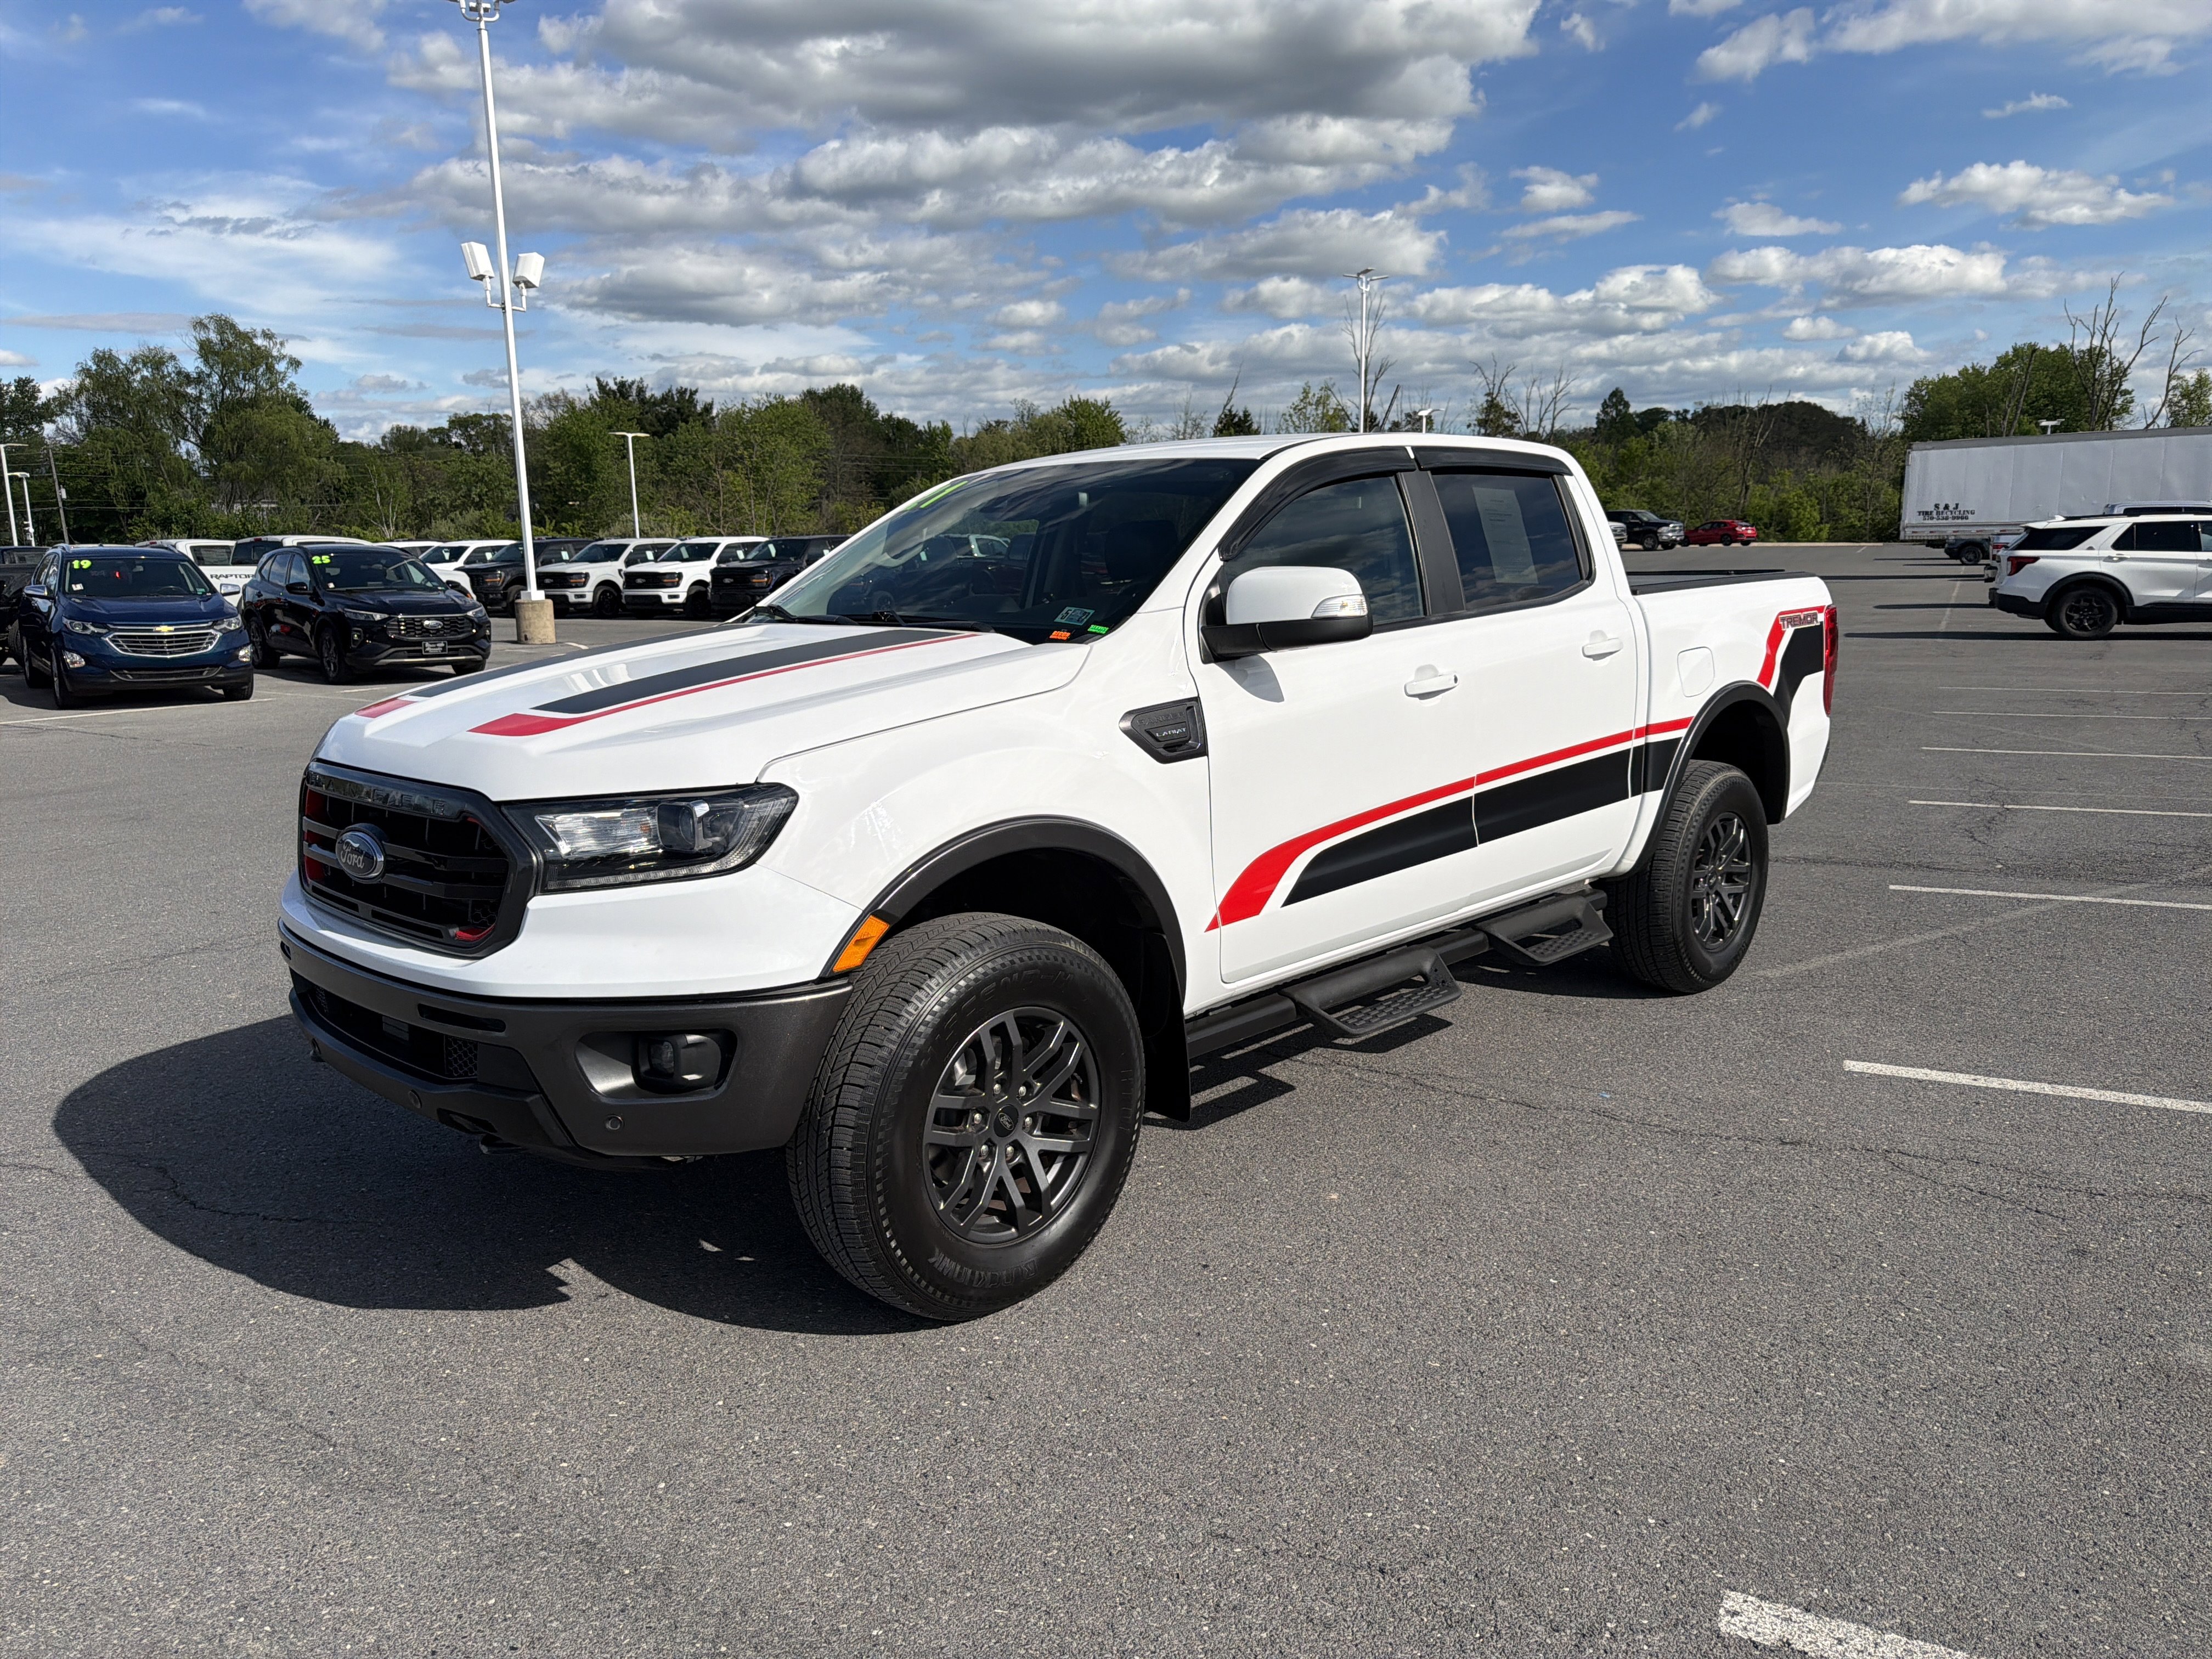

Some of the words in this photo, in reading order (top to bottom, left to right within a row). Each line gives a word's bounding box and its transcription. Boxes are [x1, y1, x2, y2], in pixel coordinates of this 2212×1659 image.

[72, 560, 92, 569] 19
[312, 555, 331, 564] 25
[1779, 612, 1819, 629] TREMOR
[1156, 727, 1186, 737] LARIAT
[340, 839, 365, 869] Ford
[1000, 1115, 1013, 1129] Ford
